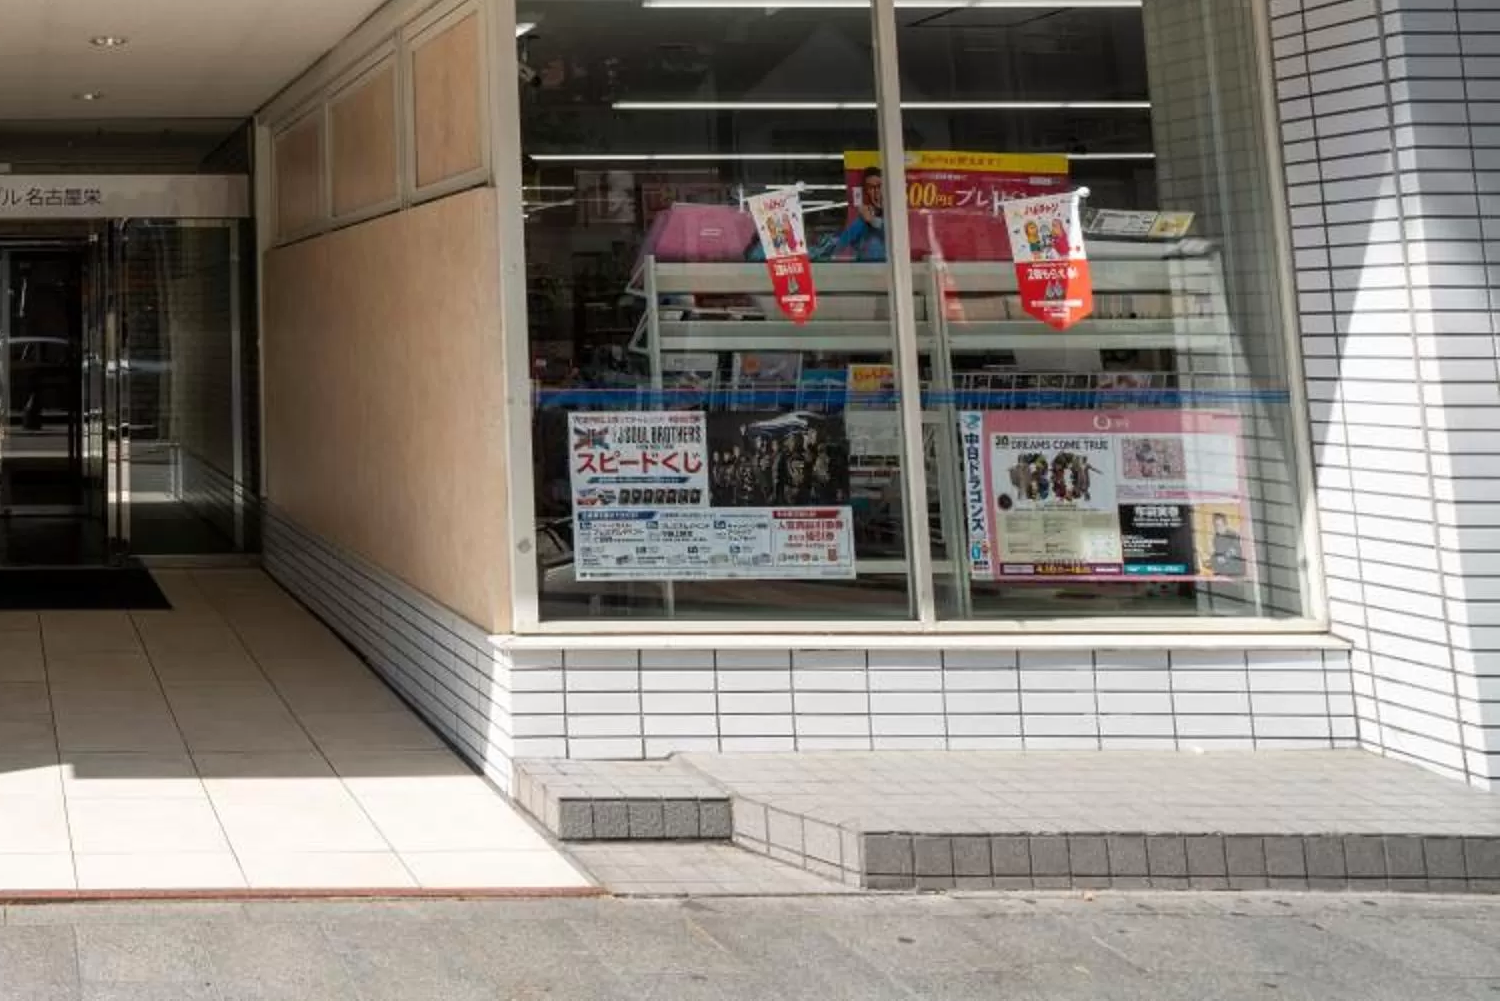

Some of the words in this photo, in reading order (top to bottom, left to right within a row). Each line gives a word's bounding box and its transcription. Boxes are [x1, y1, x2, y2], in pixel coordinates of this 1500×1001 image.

[651, 426, 701, 444] BROTHERS
[1011, 438, 1051, 450] DREAMS
[1053, 438, 1081, 450] COME
[1083, 439, 1108, 450] TRUE
[577, 450, 702, 474] スピードくじ
[964, 432, 985, 532] 中日ドラゴンズ
